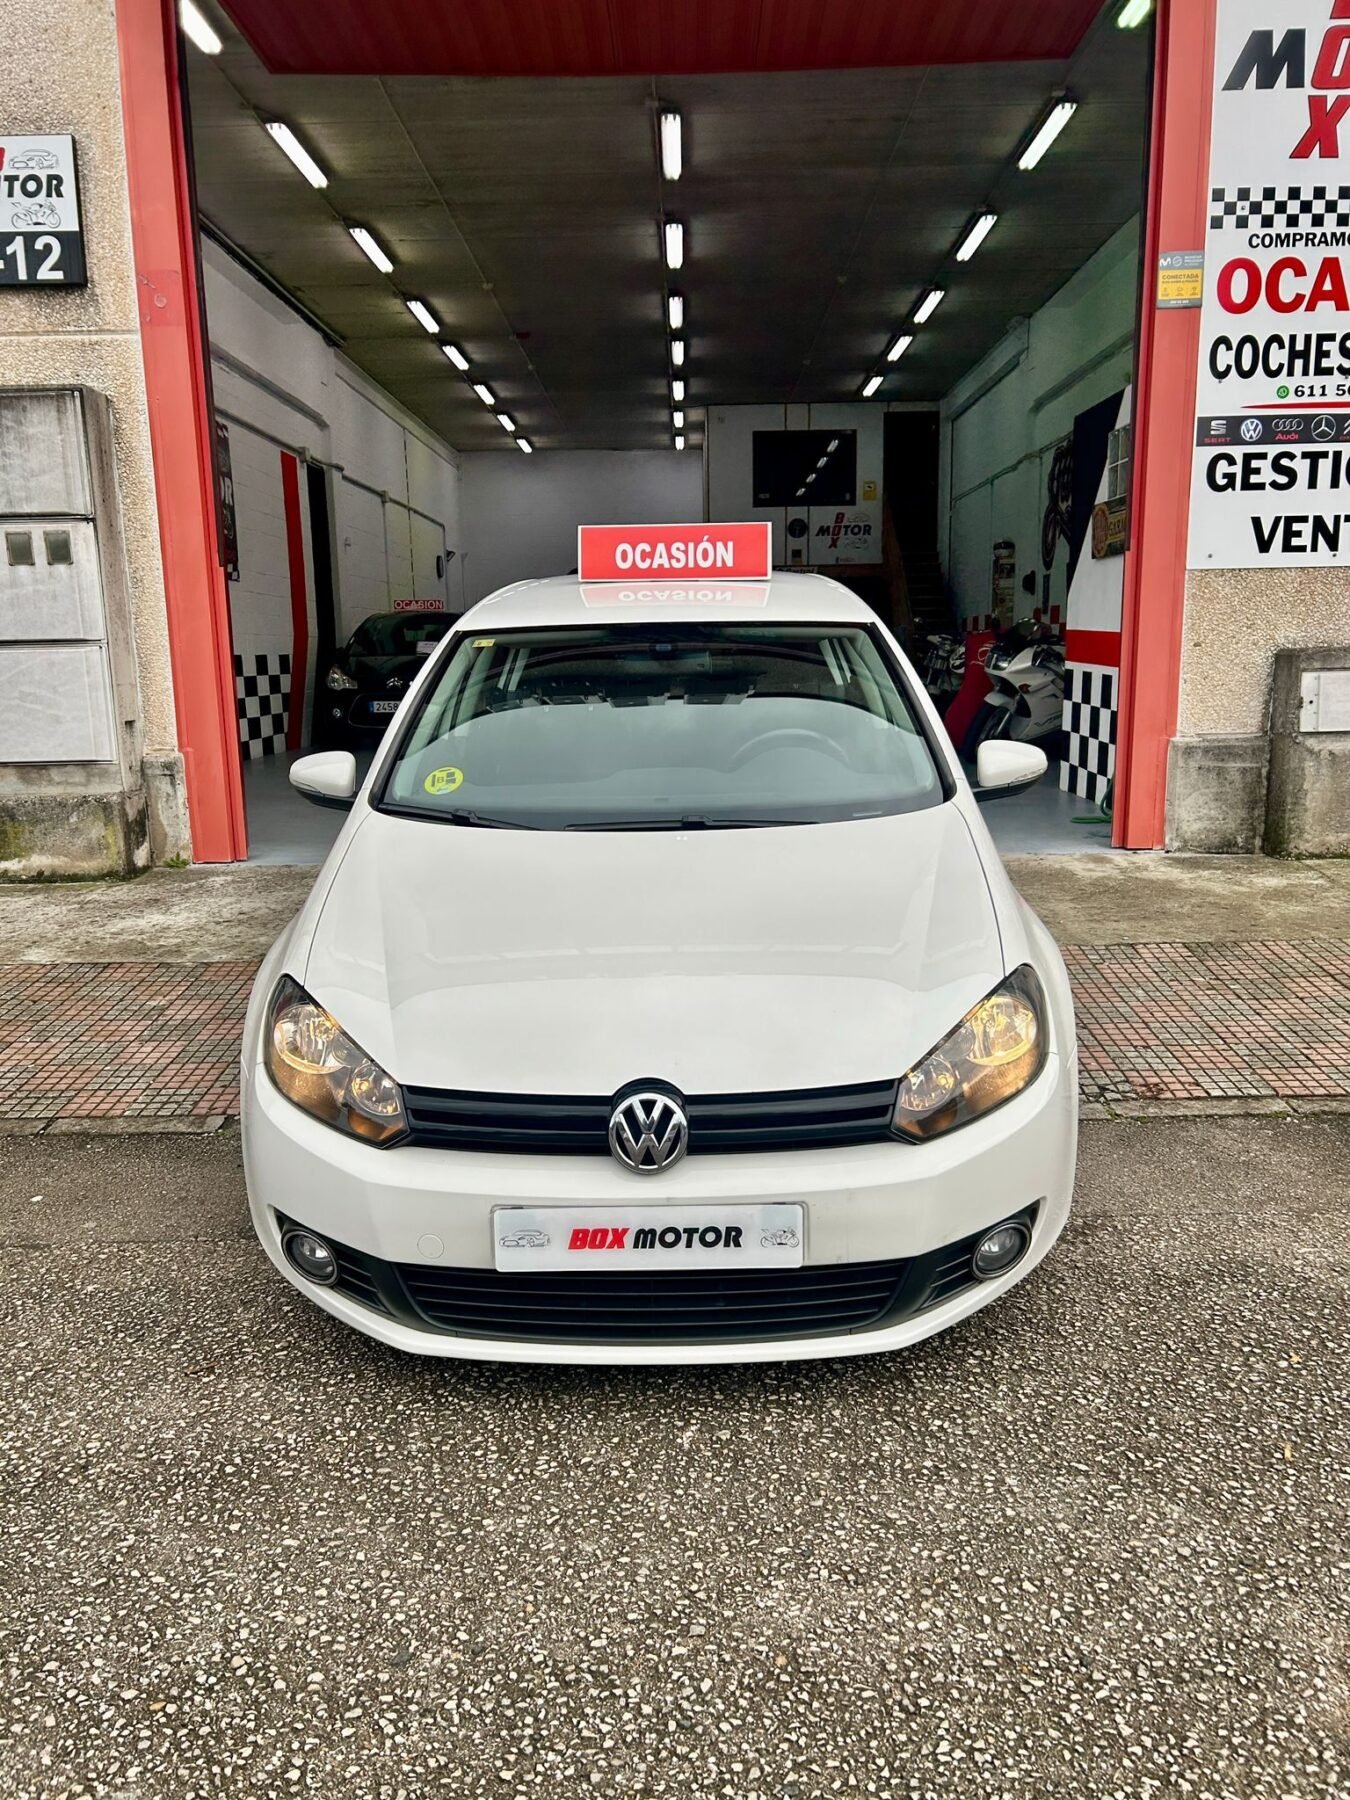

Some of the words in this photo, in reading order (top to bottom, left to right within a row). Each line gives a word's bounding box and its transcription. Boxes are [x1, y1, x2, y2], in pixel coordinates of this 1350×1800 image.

[0, 173, 64, 198] TOR
[1248, 231, 1350, 248] COMPRAM
[1217, 256, 1350, 316] OCA
[1294, 384, 1328, 398] 611
[1335, 384, 1350, 397] 5
[1206, 450, 1350, 492] GESTI
[816, 524, 872, 537] MOTOR
[1250, 514, 1350, 554] VEN
[615, 535, 734, 570] OCASIÓN
[376, 702, 398, 712] 2458
[568, 1227, 631, 1250] BOX
[632, 1226, 743, 1249] MOTOR
